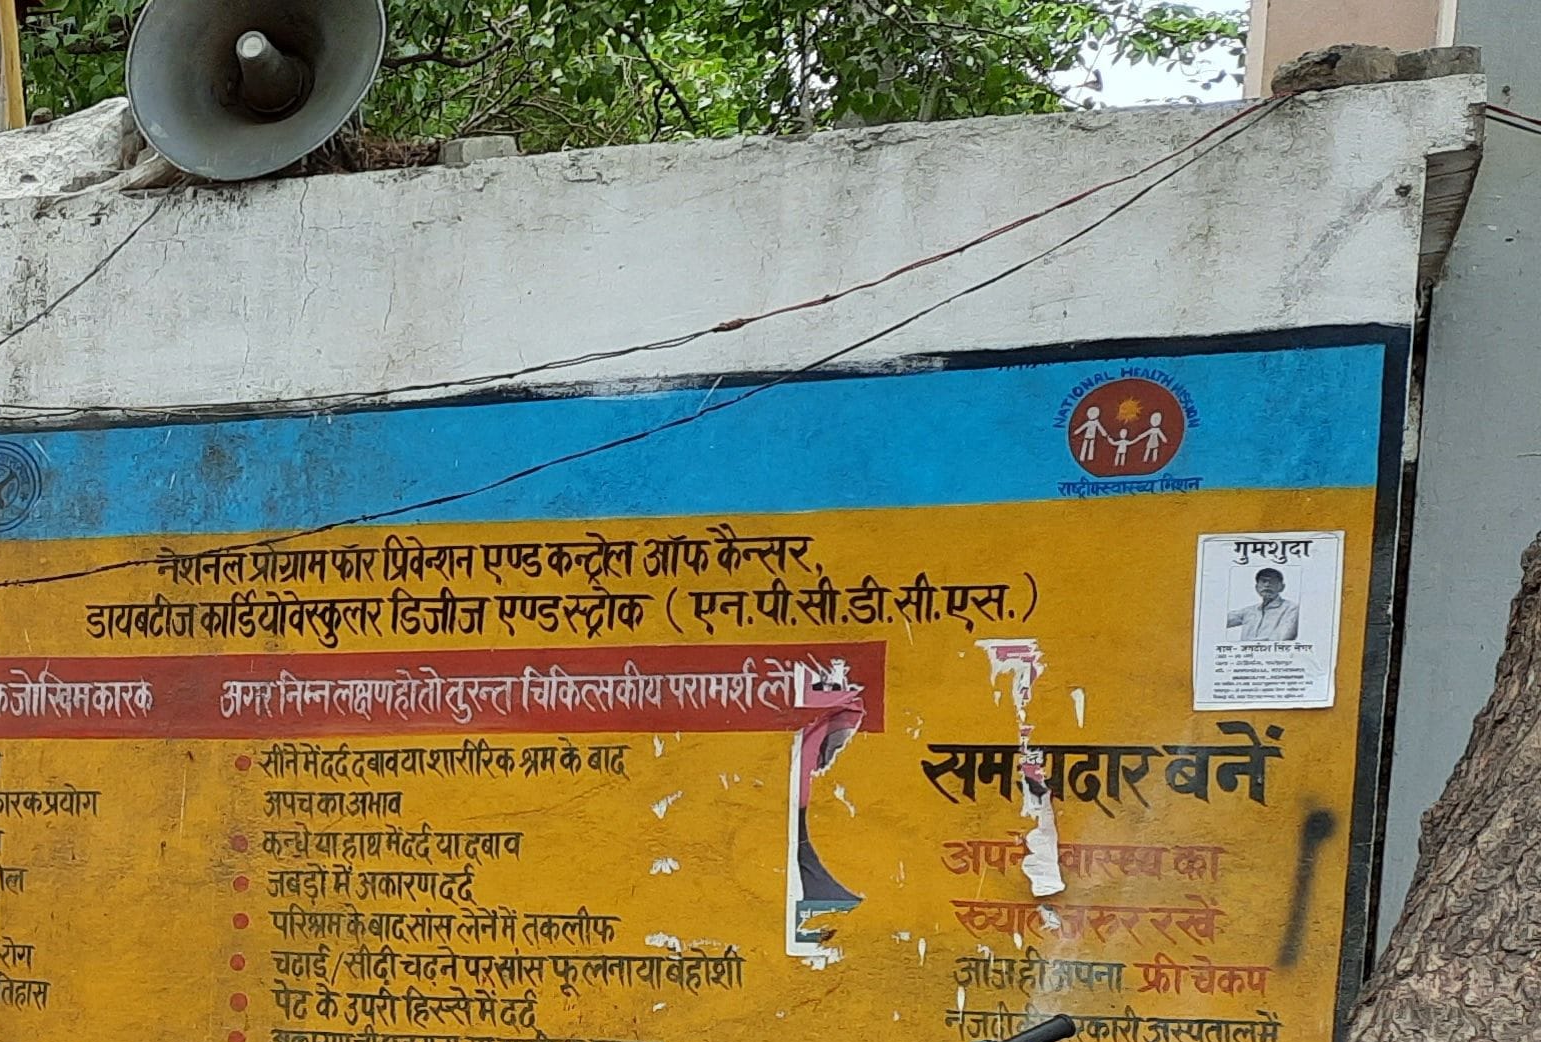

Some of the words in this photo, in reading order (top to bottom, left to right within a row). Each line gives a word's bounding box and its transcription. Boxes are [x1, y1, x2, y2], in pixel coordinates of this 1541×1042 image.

[1052, 370, 1116, 429] NATIONAL
[1120, 366, 1174, 388] HEALTH
[156, 546, 248, 585] नेशनल
[248, 543, 329, 585] प्रोग्राम
[330, 542, 381, 585] फॉर
[381, 533, 478, 584] प्रिवेन्शन
[480, 543, 544, 586] एण्ड
[543, 531, 635, 591] कन्ट्रोल
[643, 533, 712, 578] ऑफ
[1232, 539, 1314, 566] गुमशुदा
[85, 592, 199, 639] डायबटीज
[199, 588, 384, 649] कार्डियोवेस्कुलर
[387, 586, 492, 636] डिजीज
[494, 594, 563, 638] एण्ड
[562, 584, 656, 640] स्ट्रोक
[93, 675, 155, 719] कारक
[218, 678, 275, 719] अगर
[274, 668, 332, 720] निम्न
[332, 676, 395, 722] लक्षण
[446, 674, 519, 725] तुरन्त
[518, 658, 667, 713] चिकित्सकीय
[666, 657, 759, 712] परामर्श
[257, 741, 301, 782] सीने
[300, 741, 321, 780] में
[319, 740, 353, 784] दर्द
[352, 747, 401, 786] दबाव
[400, 748, 427, 777] या
[425, 738, 516, 782] शारीरिक
[517, 745, 558, 782] श्रम
[557, 737, 582, 776] के
[586, 744, 631, 782] बाद
[1161, 720, 1287, 807] बनें
[40, 782, 102, 817] प्रयोग
[263, 791, 317, 819] अपच
[316, 791, 347, 819] का
[346, 790, 404, 819] अभाव
[314, 831, 341, 860] या
[339, 831, 385, 864] हाथ
[384, 823, 403, 859] में
[401, 822, 434, 865] दर्द
[433, 831, 465, 861] या
[463, 831, 524, 866] दबाव
[332, 863, 354, 900] में
[356, 870, 440, 902] अकारण
[438, 861, 476, 903] दर्द
[270, 903, 345, 944] परिश्रम
[343, 904, 369, 942] के
[367, 912, 413, 944] बाद
[409, 911, 456, 944] सांस
[499, 905, 519, 945] में
[520, 904, 621, 947] तकलीफ
[462, 955, 497, 989] पर
[631, 956, 666, 988] या
[664, 944, 747, 991] बेहोशी
[1018, 945, 1051, 998] ही
[1132, 951, 1190, 996] फ्री
[270, 982, 310, 1022] पेट
[313, 983, 341, 1021] के
[402, 982, 475, 1029] हिस्से
[474, 986, 501, 1028] में
[497, 984, 540, 1031] दर्द
